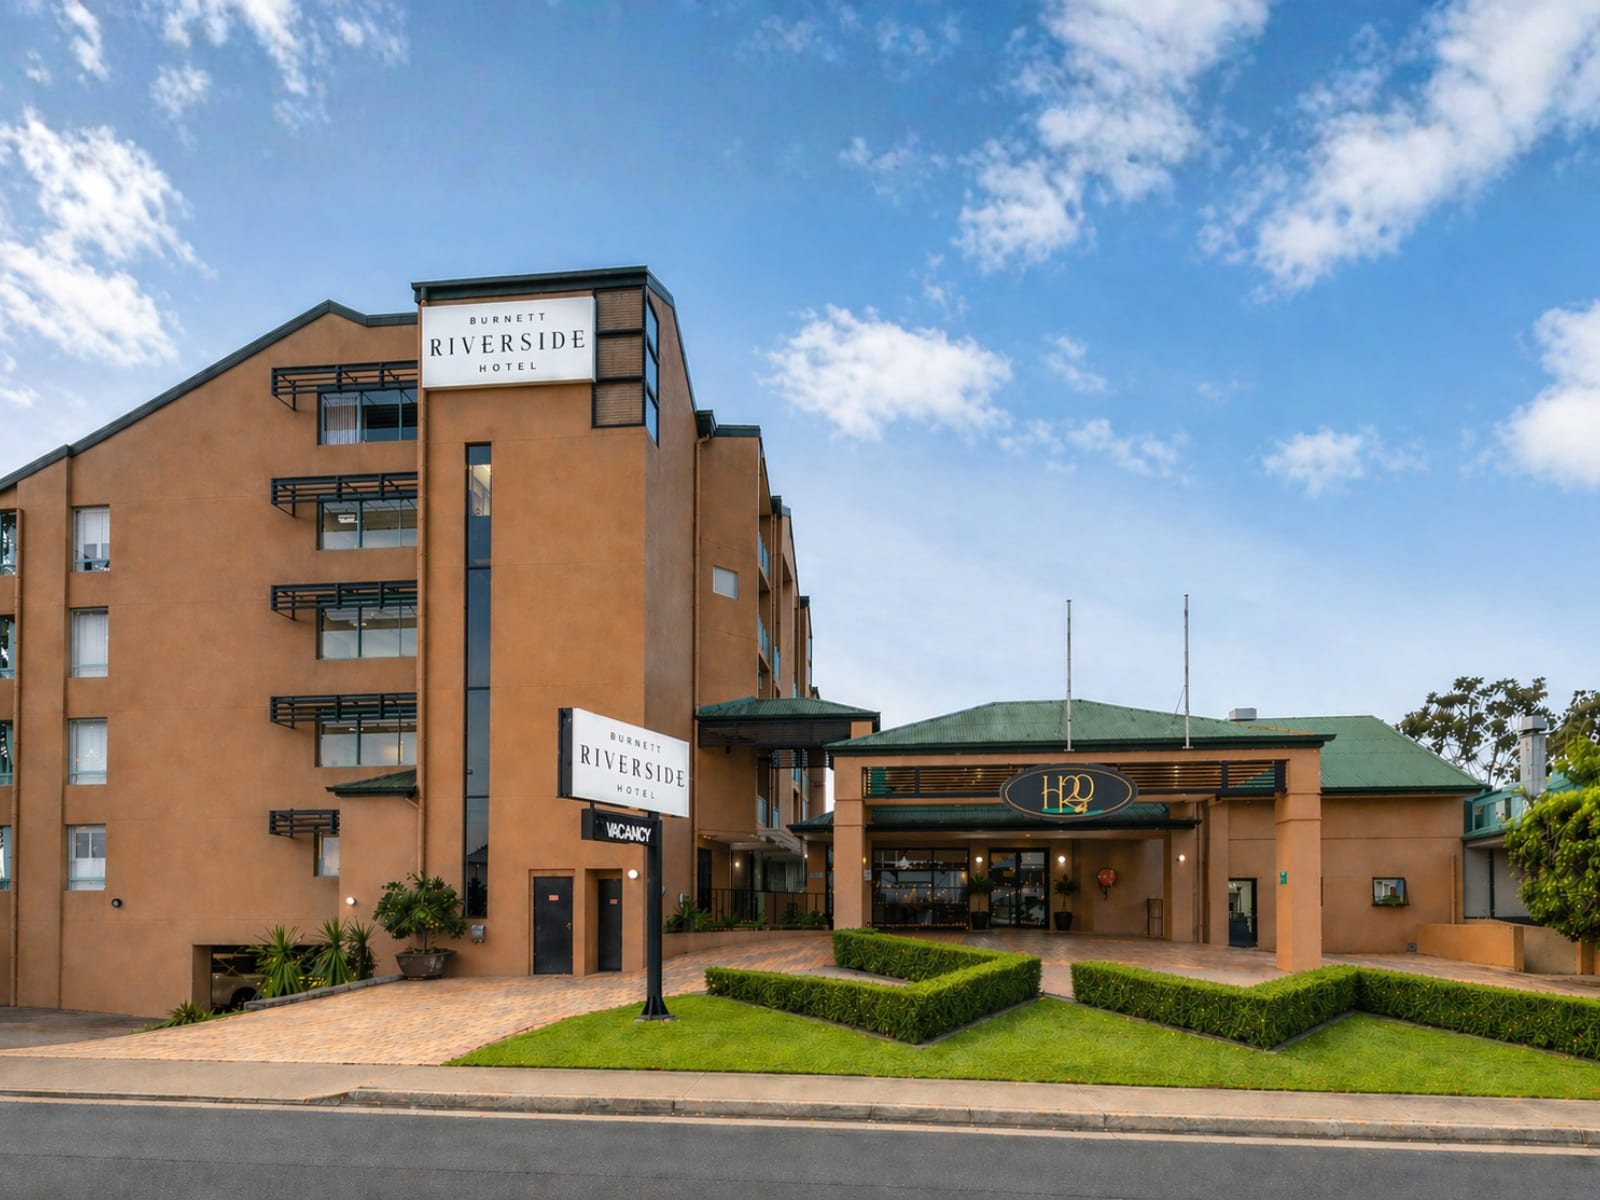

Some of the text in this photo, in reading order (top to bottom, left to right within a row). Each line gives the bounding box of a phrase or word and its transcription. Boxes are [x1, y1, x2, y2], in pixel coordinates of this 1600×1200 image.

[469, 312, 546, 325] BURNETT
[430, 329, 585, 357] RIVERSIDE
[479, 361, 537, 373] HOTEL
[610, 731, 662, 753] BURNETT
[579, 744, 685, 788] RIVERSIDE
[617, 784, 655, 800] HOTEL
[606, 821, 651, 842] VACANCY
